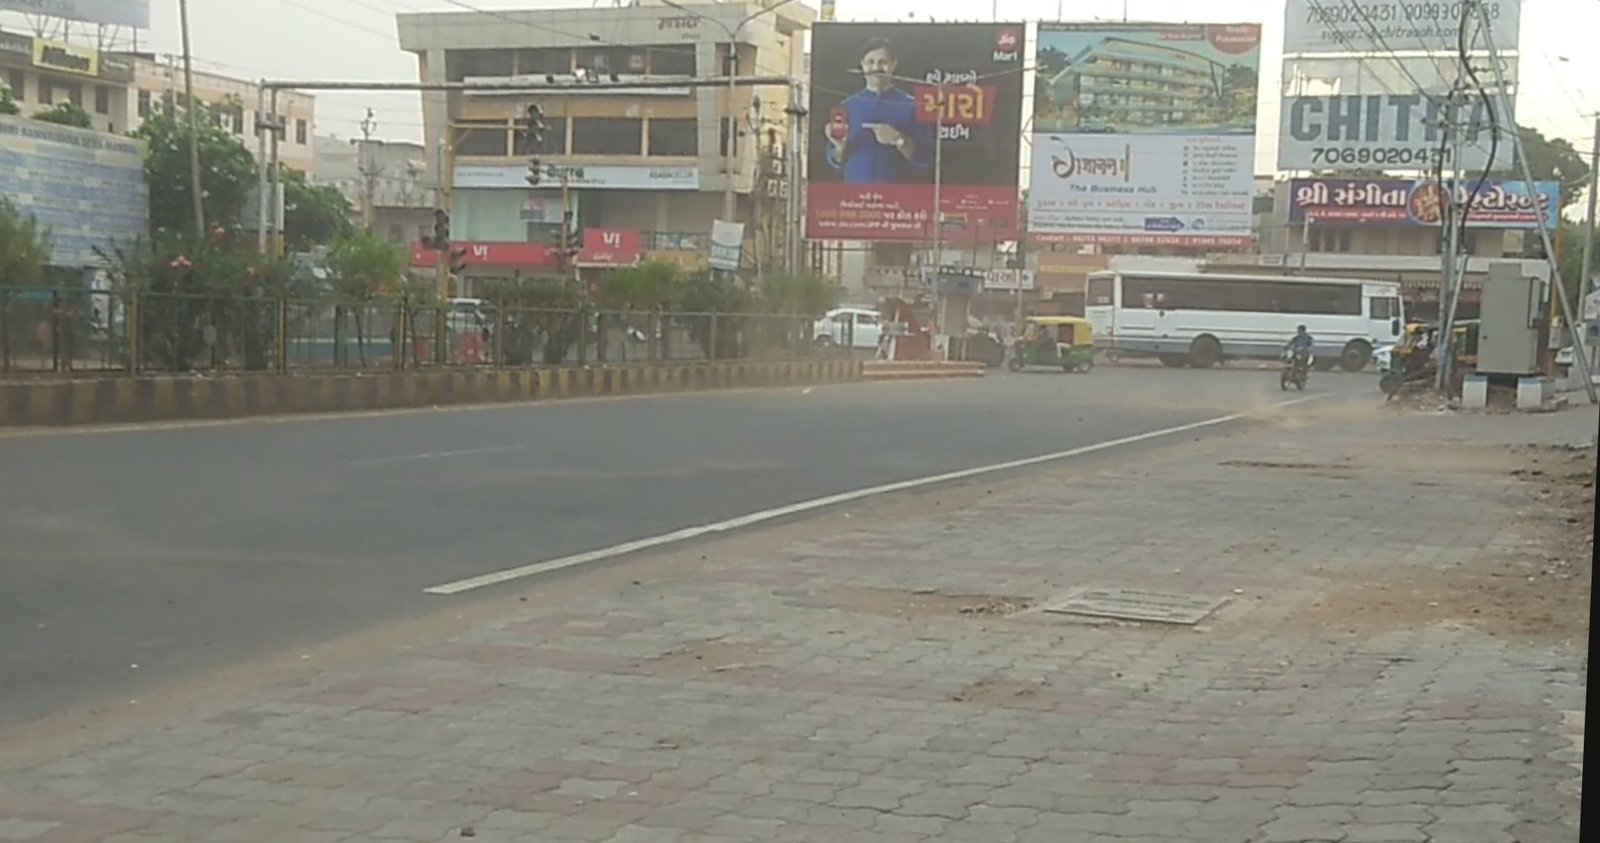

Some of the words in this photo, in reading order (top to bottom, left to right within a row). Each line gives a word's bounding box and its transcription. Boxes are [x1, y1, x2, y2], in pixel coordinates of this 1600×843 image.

[998, 33, 1016, 44] Jio
[993, 51, 1018, 61] Mart
[1312, 148, 1450, 164] 7069020431
[1070, 184, 1087, 192] The
[1091, 184, 1134, 193] Business
[1138, 184, 1157, 193] Hub
[1296, 181, 1329, 206] શ્રી
[1334, 182, 1407, 206] સંગીતા
